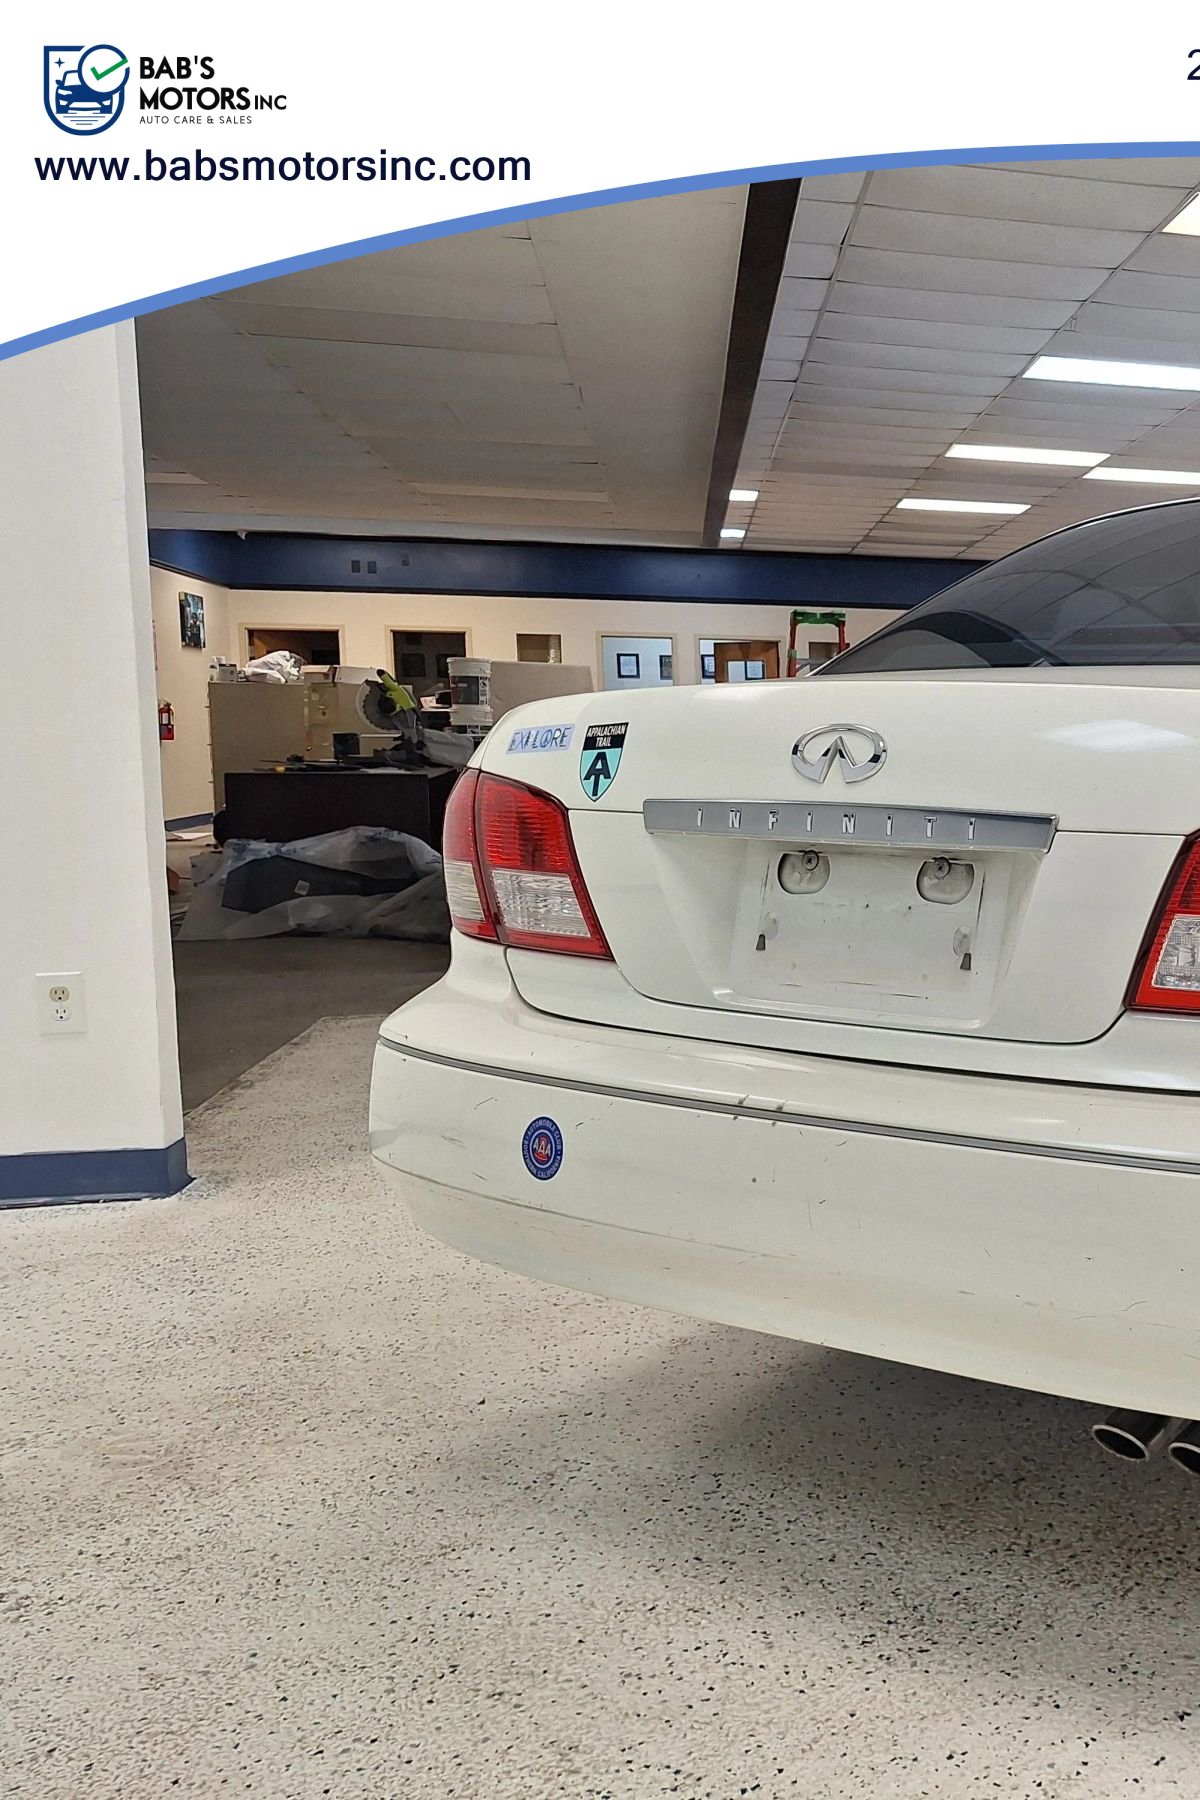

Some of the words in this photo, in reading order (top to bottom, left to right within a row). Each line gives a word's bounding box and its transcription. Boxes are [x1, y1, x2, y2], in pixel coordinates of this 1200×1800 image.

[587, 724, 627, 737] APPALACHIAN
[595, 736, 612, 748] TRAIL
[696, 806, 976, 840] INFINITI
[533, 1138, 551, 1157] AAA
